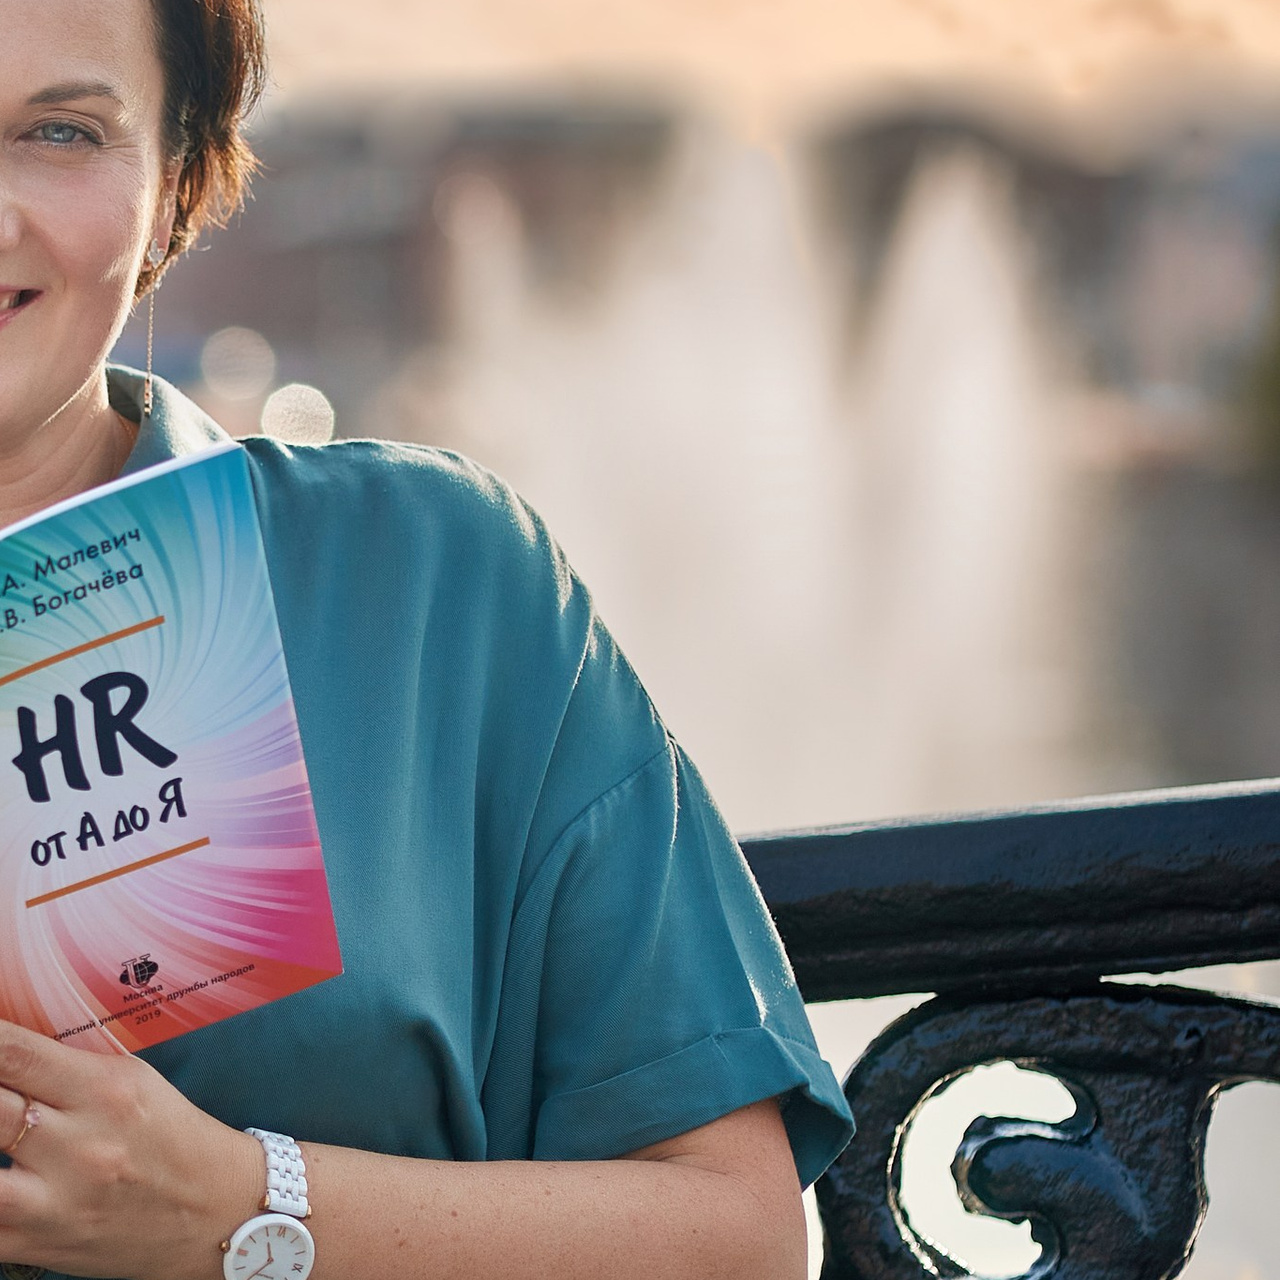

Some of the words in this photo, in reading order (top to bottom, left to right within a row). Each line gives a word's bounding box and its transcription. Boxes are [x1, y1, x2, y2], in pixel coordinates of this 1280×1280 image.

[34, 528, 141, 581] Малевич
[33, 564, 144, 616] Богачёва
[12, 671, 178, 803] HR
[53, 1020, 96, 1041] сийский
[99, 997, 163, 1028] университет
[167, 979, 208, 1002] дружбы
[211, 963, 255, 985] народов
[123, 984, 163, 1003] Москва
[136, 1009, 161, 1025] 2019
